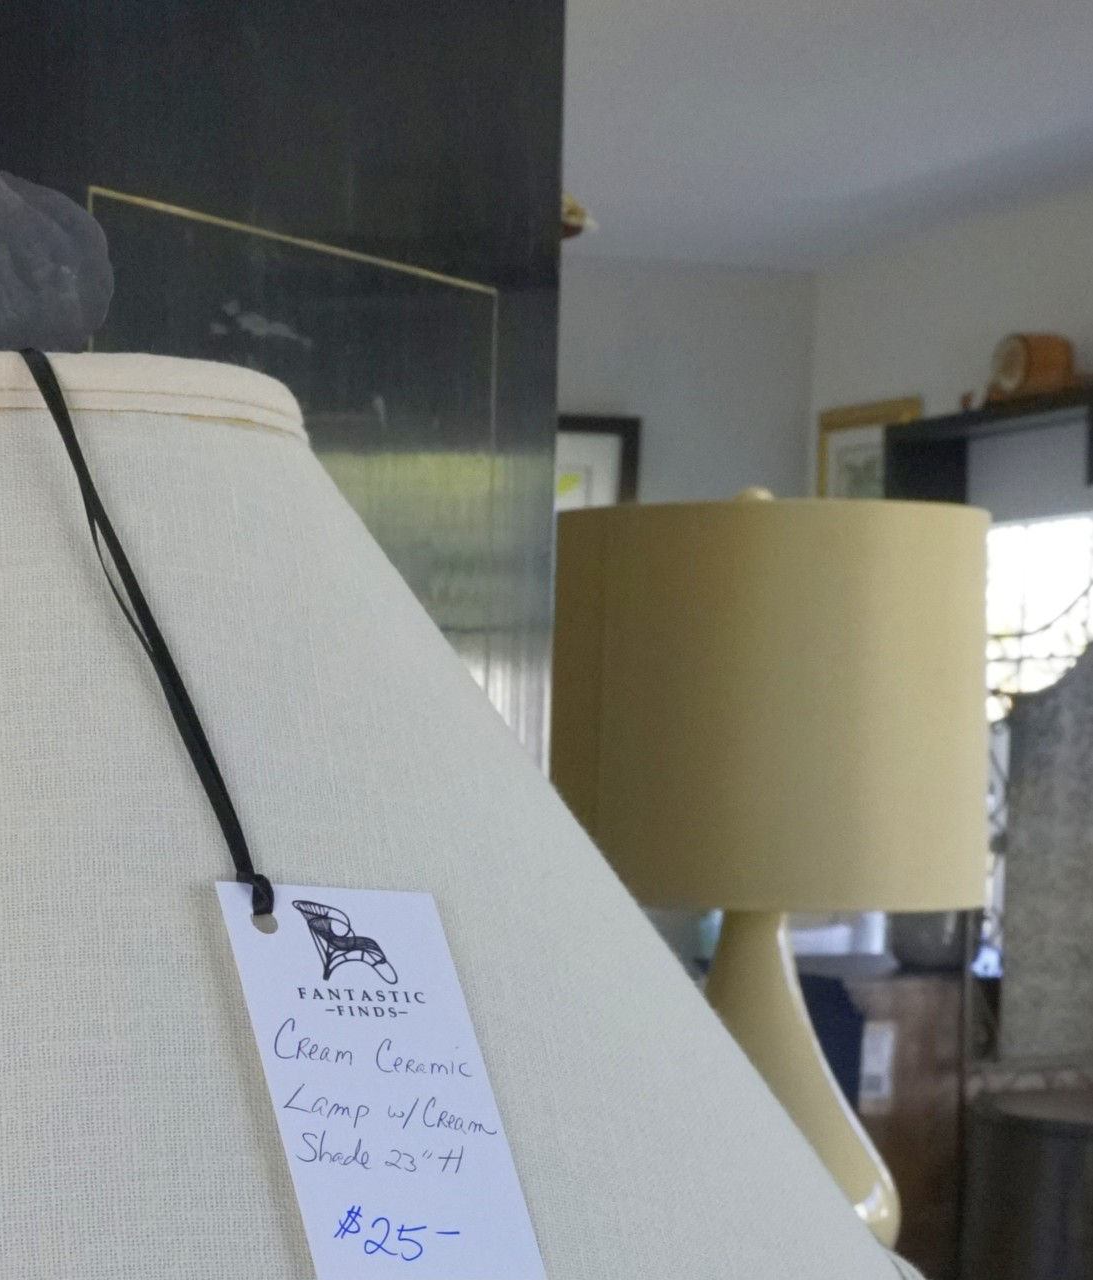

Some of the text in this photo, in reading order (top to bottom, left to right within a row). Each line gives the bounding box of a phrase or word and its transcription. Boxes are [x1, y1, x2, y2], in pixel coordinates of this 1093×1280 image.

[298, 986, 426, 1004] FANTASTIC
[283, 1083, 370, 1130] Lamp
[296, 1132, 371, 1170] Shade
